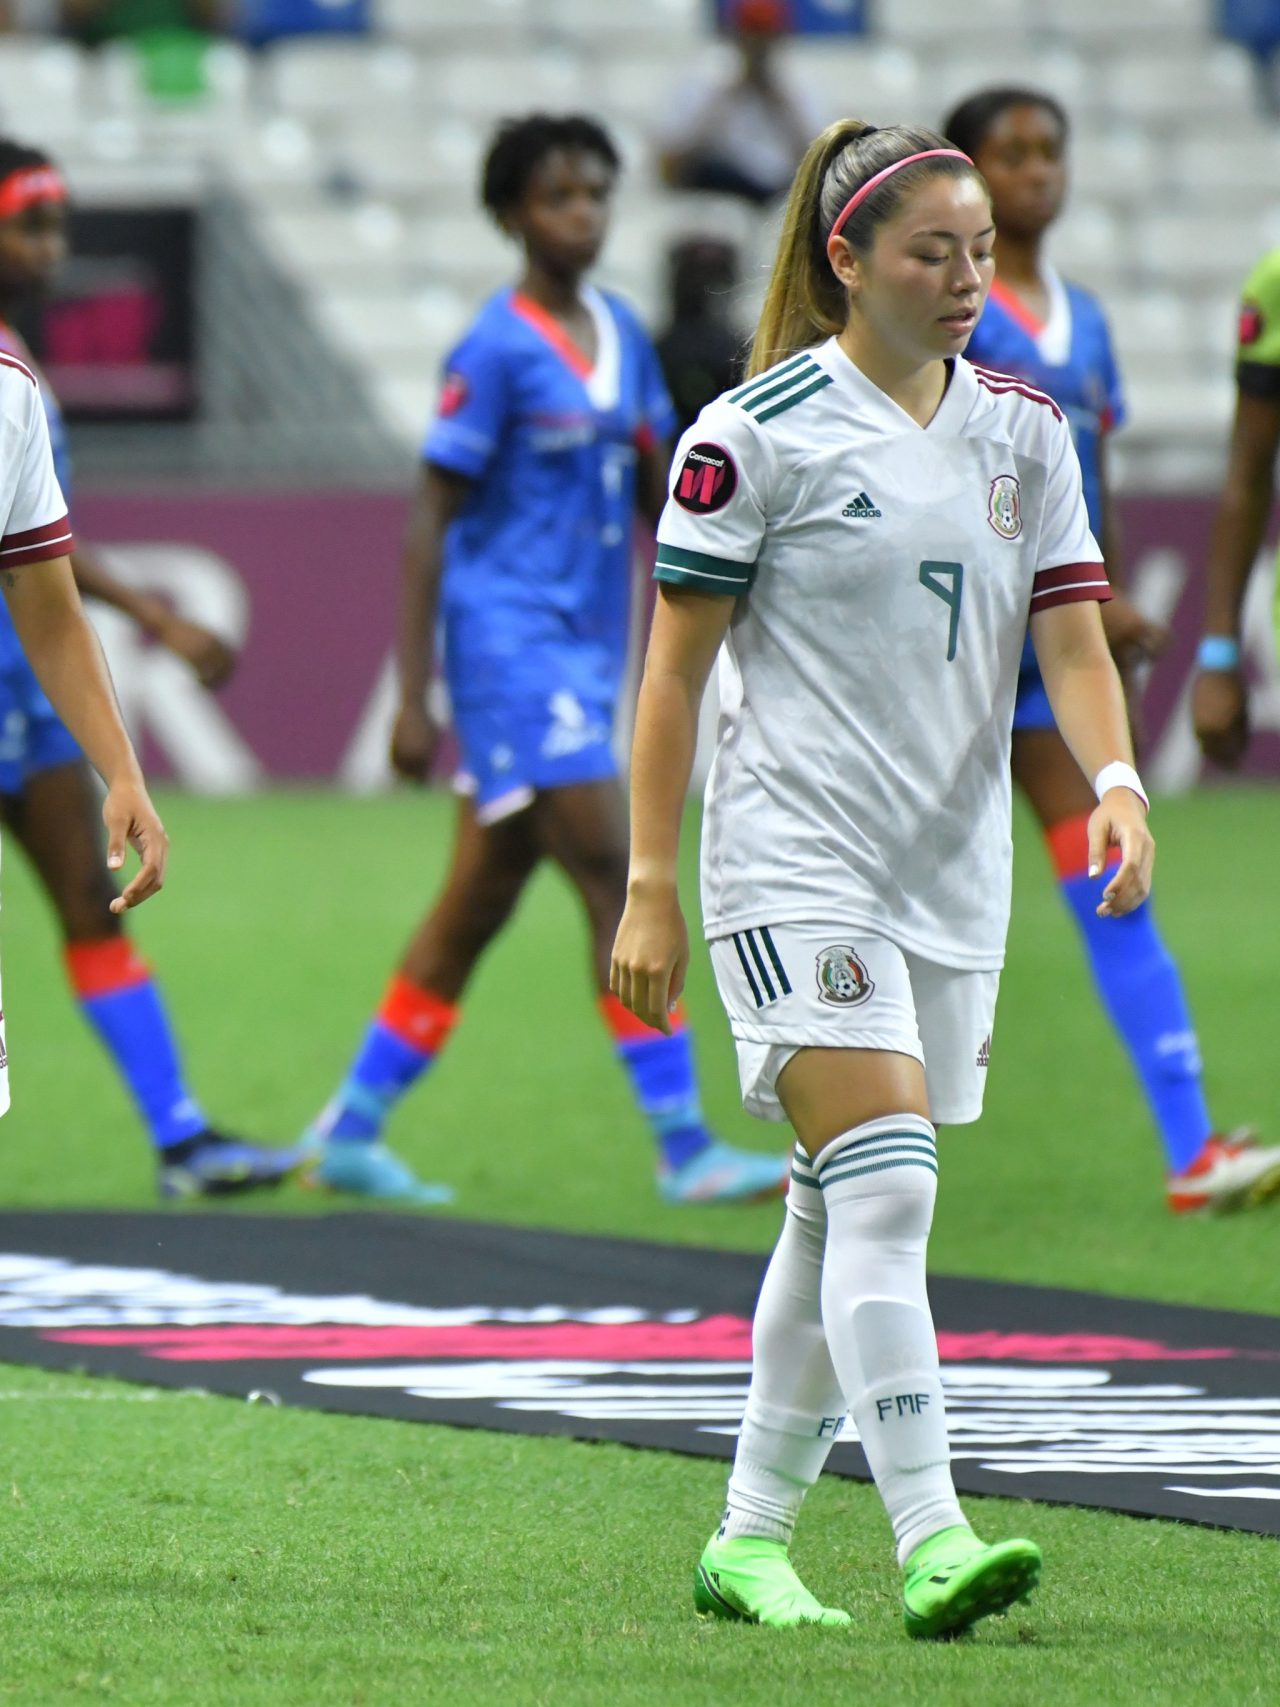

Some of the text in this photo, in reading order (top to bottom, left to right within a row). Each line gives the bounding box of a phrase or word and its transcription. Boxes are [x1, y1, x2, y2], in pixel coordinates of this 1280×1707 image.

[688, 450, 725, 468] Concacaf
[841, 507, 882, 519] adidas
[918, 559, 964, 662] 9
[875, 1393, 930, 1422] FMF
